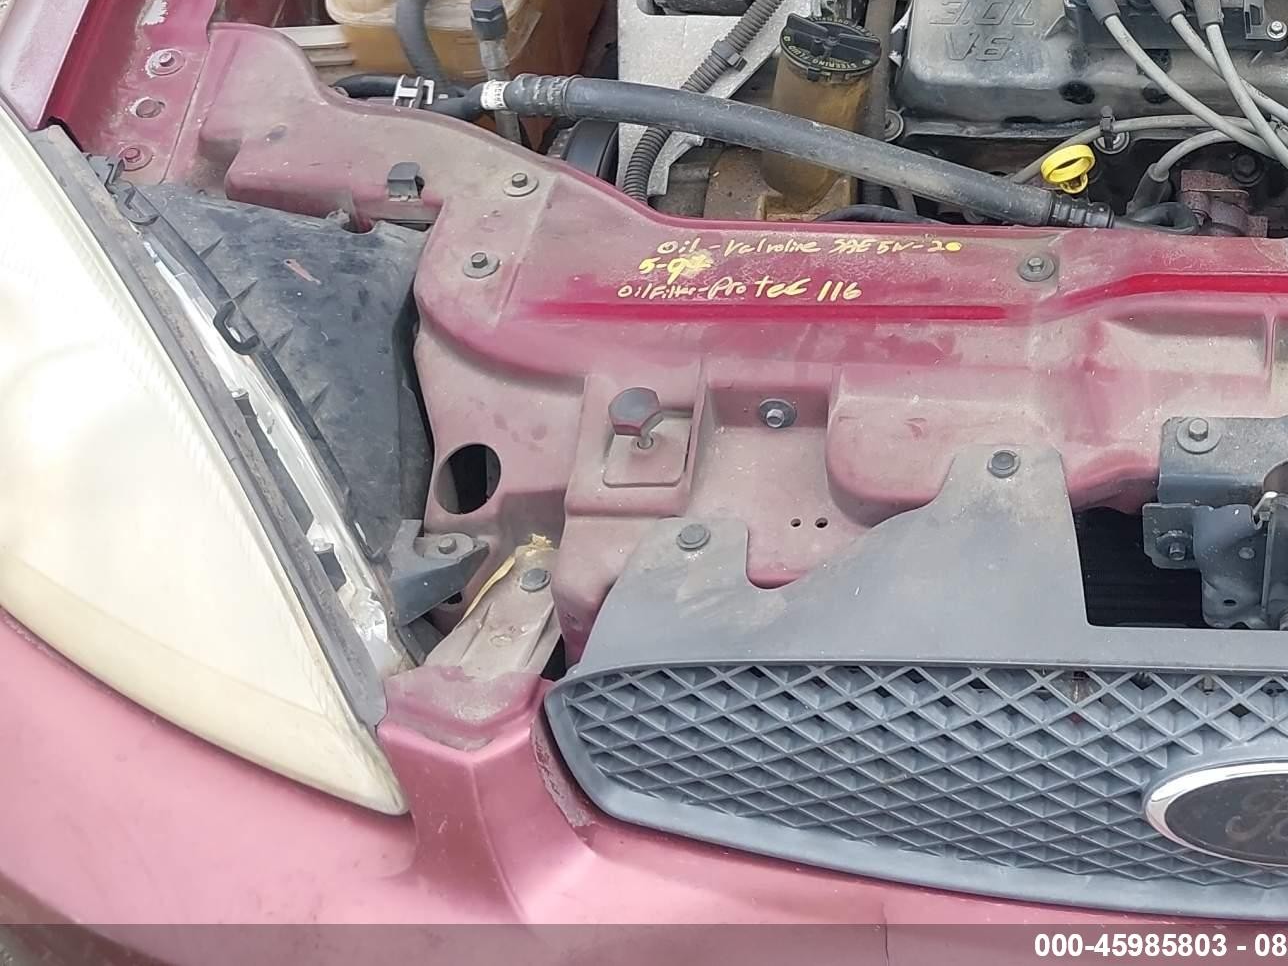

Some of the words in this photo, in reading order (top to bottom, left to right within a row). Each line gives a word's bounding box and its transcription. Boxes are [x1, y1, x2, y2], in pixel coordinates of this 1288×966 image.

[945, 32, 1015, 61] V6
[812, 57, 858, 69] STEERING
[657, 238, 701, 254] Oil
[816, 280, 862, 301] 116
